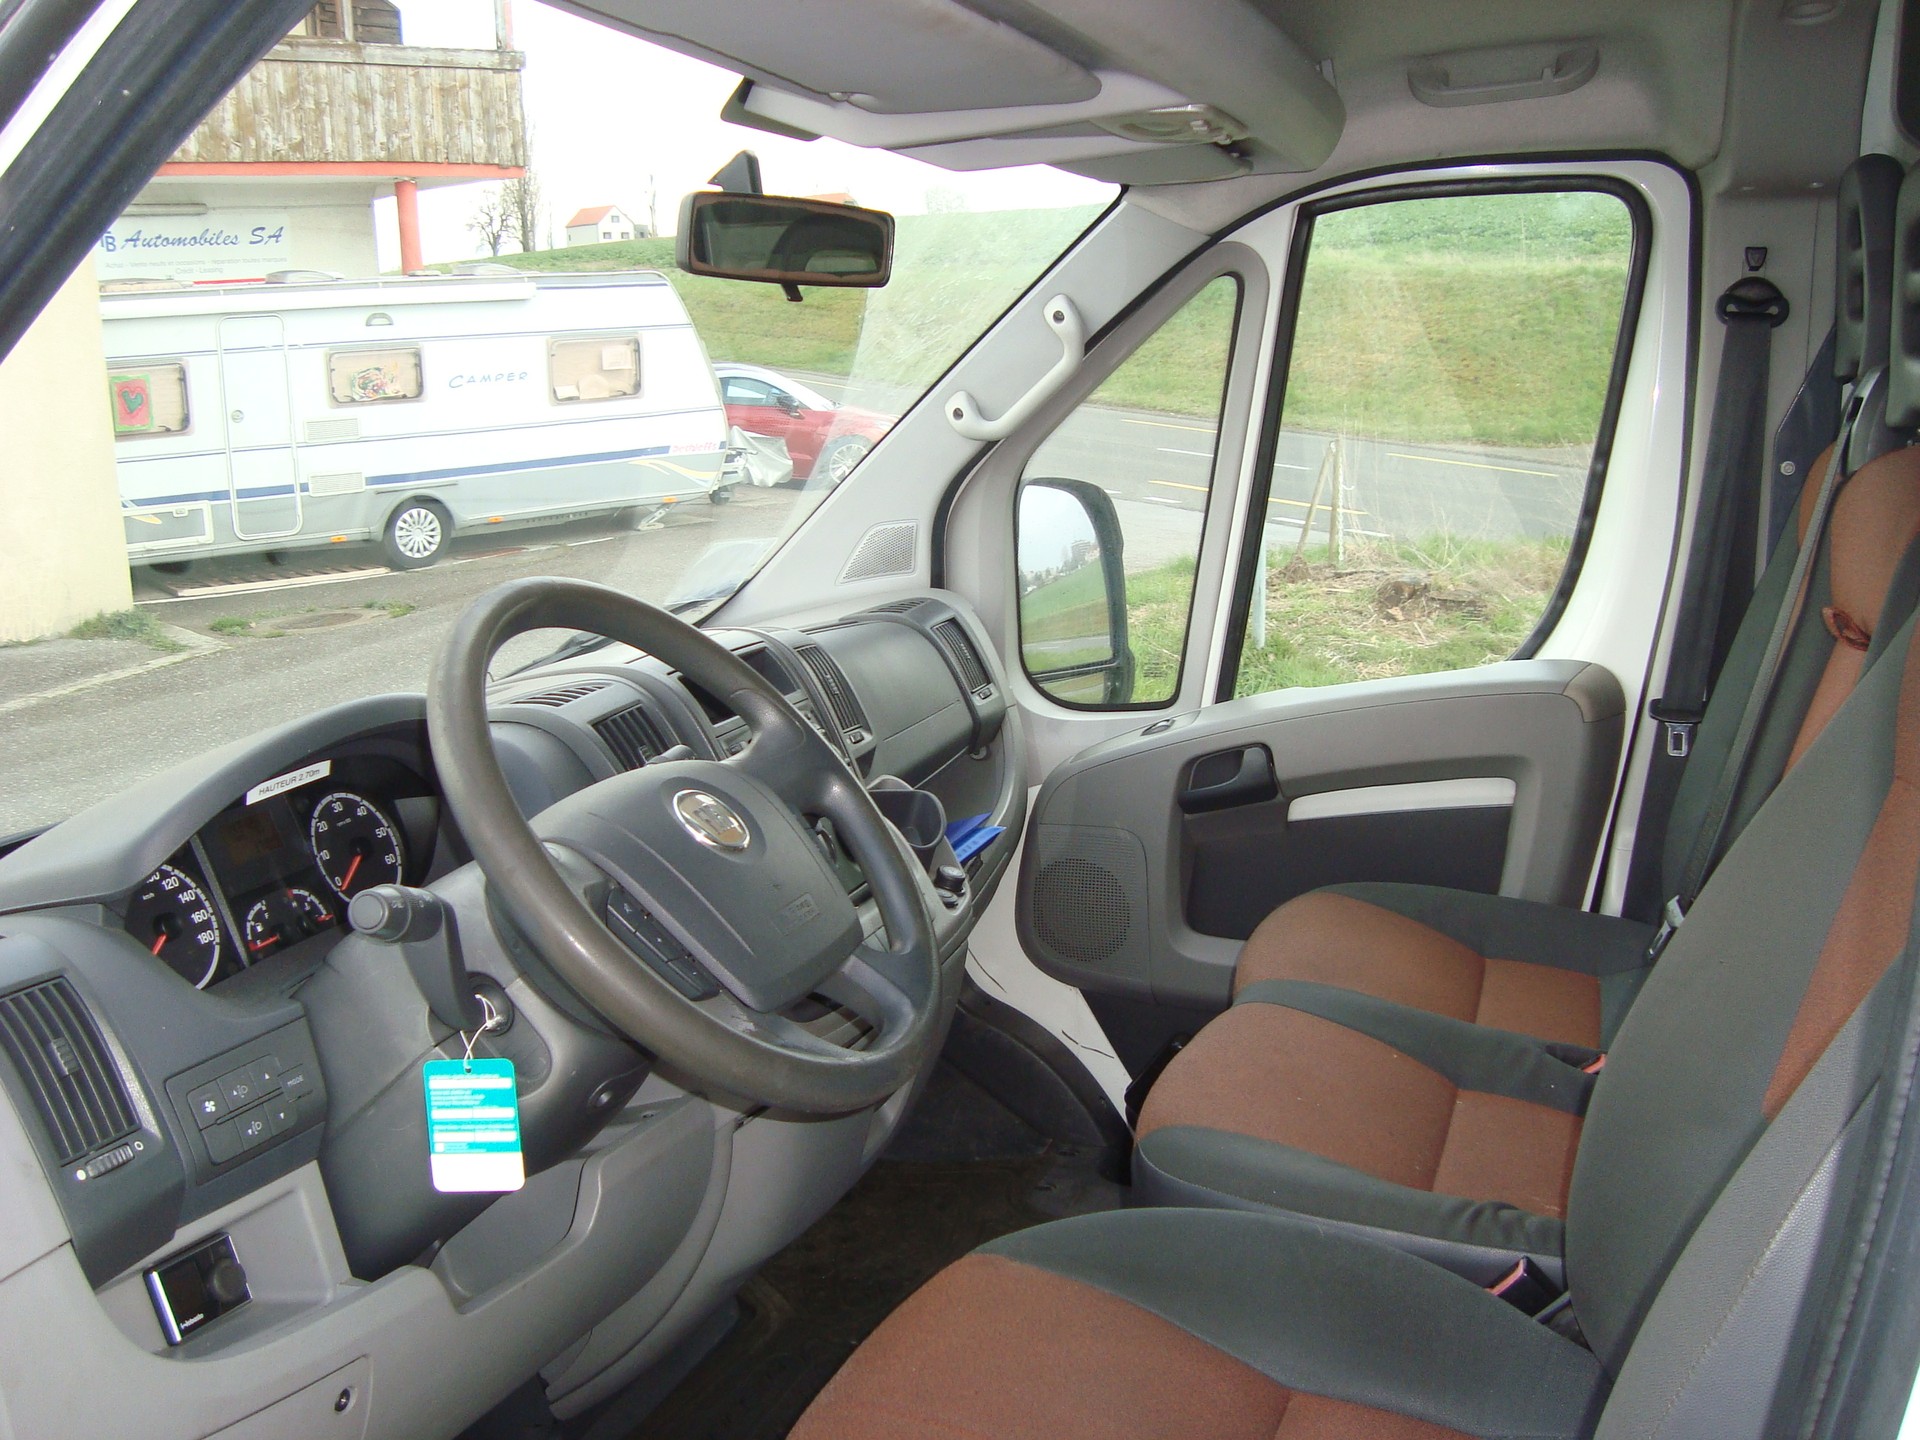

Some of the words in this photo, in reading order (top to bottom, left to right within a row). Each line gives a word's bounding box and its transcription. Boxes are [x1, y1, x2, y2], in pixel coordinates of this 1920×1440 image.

[121, 229, 240, 249] Automobiles
[249, 226, 284, 245] SA
[449, 372, 528, 389] CAMPER
[258, 775, 298, 797] HAUTEUR
[332, 801, 344, 813] 30
[357, 805, 367, 817] 40
[316, 820, 329, 833] 20
[375, 827, 387, 838] 50
[320, 849, 330, 862] 10
[384, 853, 396, 865] 60
[162, 876, 180, 891] 120
[335, 876, 342, 886] 0
[178, 889, 195, 904] 140
[191, 910, 208, 925] 160
[197, 930, 214, 945] 180
[287, 1074, 305, 1088] MODE
